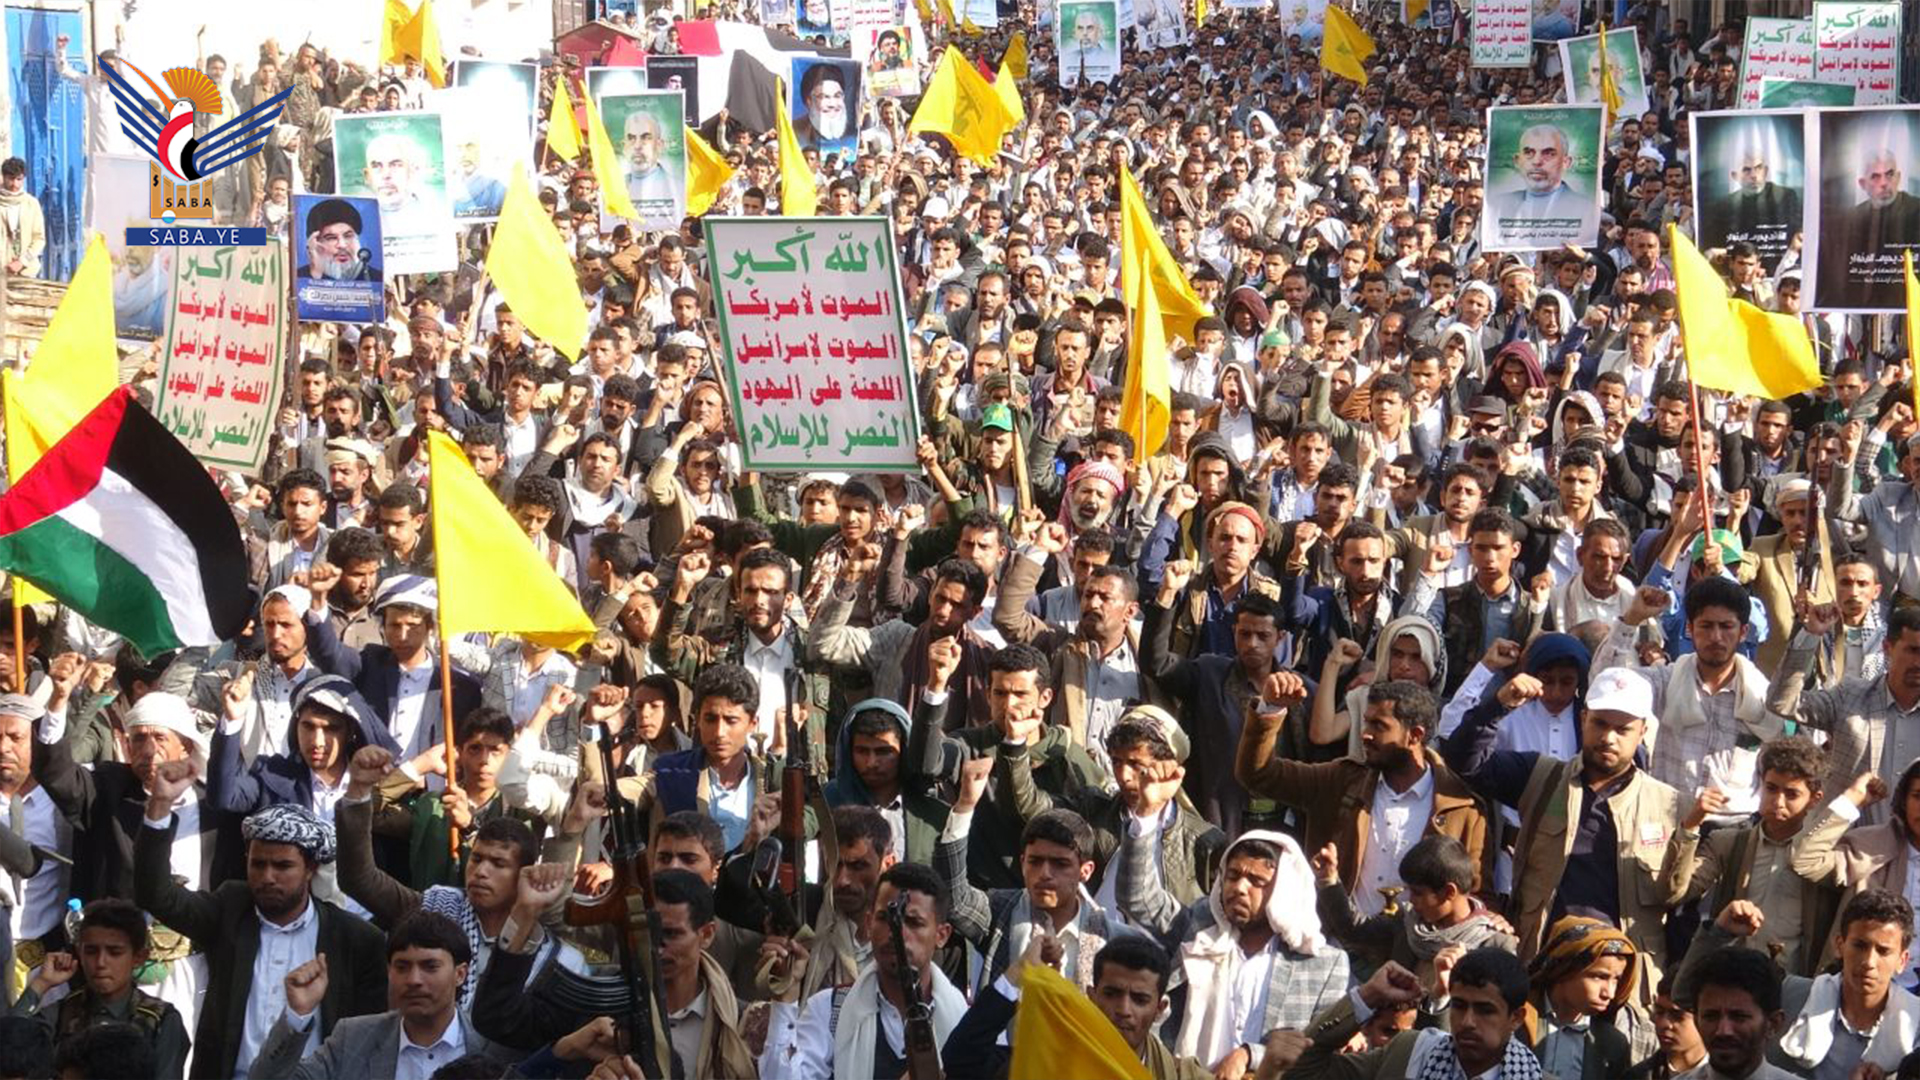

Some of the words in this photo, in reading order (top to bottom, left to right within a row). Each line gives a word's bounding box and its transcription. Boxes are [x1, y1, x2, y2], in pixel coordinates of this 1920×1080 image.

[1821, 6, 1865, 33] أكبر
[1751, 23, 1796, 47] أكبر
[1819, 33, 1858, 51] لأمريكا
[1862, 36, 1895, 52] الموت
[1818, 56, 1858, 72] لإسرائيل
[1862, 56, 1895, 72] الموت
[722, 226, 815, 285] أكبر
[825, 230, 885, 272] الله
[178, 290, 226, 322] لأمريكا
[230, 302, 275, 328] الموت
[727, 282, 815, 322] لأمريكا
[821, 290, 891, 321] الموت
[174, 330, 221, 365] لإسرائيل
[226, 342, 273, 367] الموت
[737, 331, 821, 365] لإسرائيل
[828, 333, 897, 363] الموت
[168, 372, 203, 397] اليهود
[204, 374, 224, 401] على
[231, 376, 269, 405] اللعنة
[742, 373, 802, 407] اليهود
[810, 375, 841, 406] على
[851, 374, 903, 402] اللعنة
[207, 412, 261, 450] النصر
[749, 412, 829, 460] للإسلام
[839, 409, 909, 457] النصر
